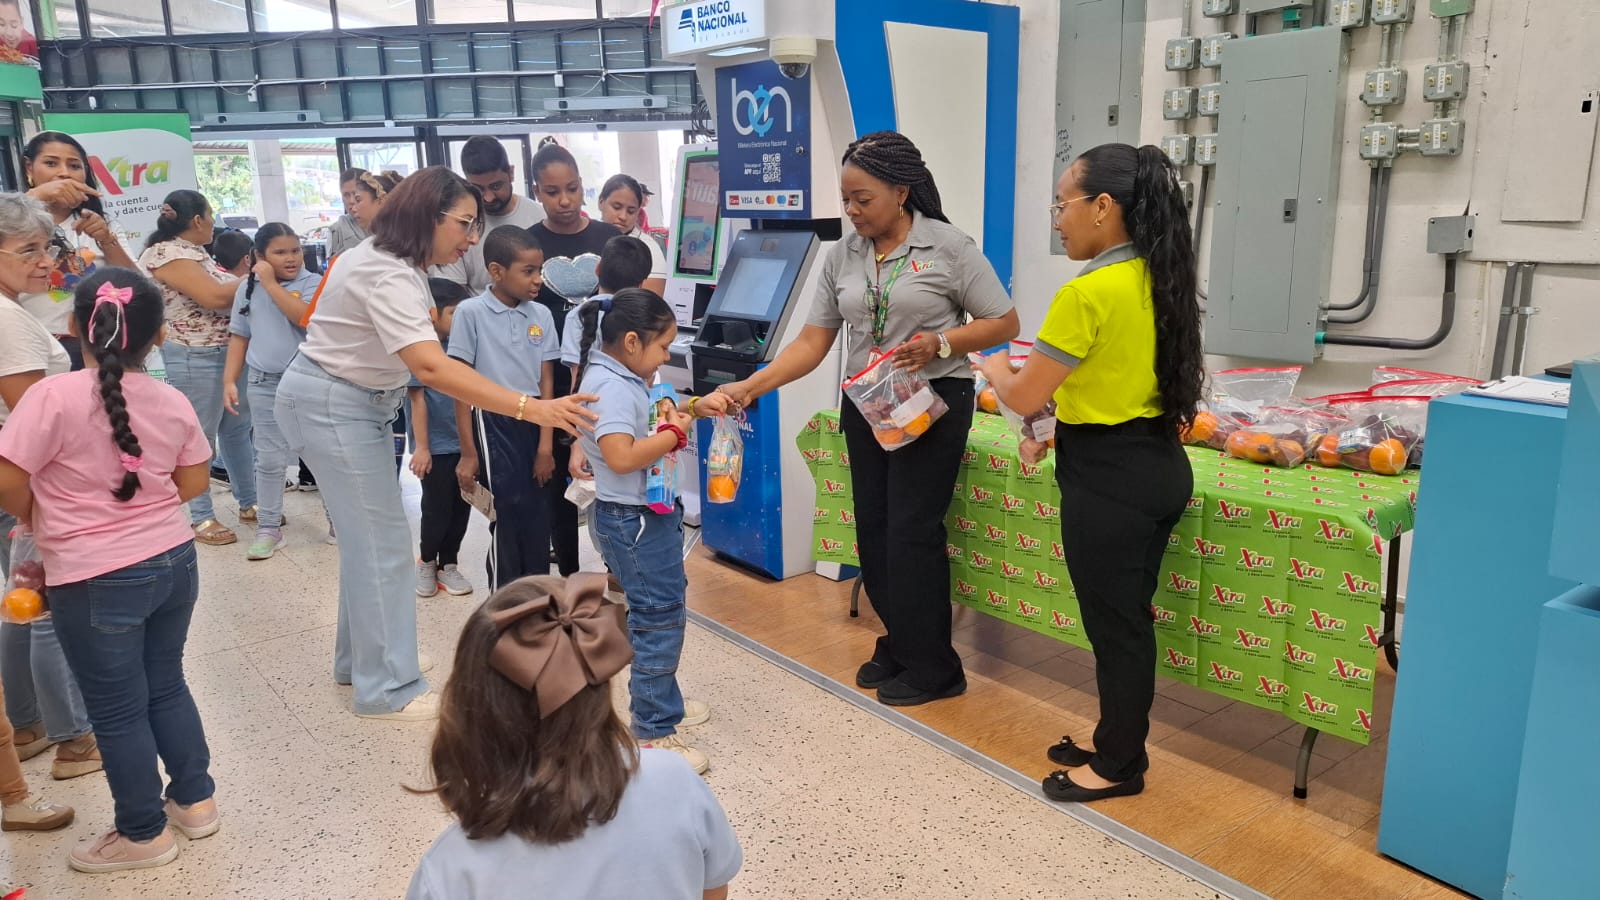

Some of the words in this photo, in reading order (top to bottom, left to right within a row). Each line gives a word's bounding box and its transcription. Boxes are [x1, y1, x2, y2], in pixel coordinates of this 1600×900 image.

[697, 1, 730, 18] BANCO
[698, 12, 747, 31] NACIONAL
[85, 155, 169, 195] Xtra
[105, 200, 114, 208] la
[116, 196, 149, 207] cuenta
[741, 196, 753, 204] VISA
[114, 210, 120, 218] y
[122, 206, 145, 216] date
[147, 204, 163, 212] cue
[908, 259, 934, 273] Xtra
[987, 454, 1010, 470] Xtra
[1018, 461, 1041, 477] Xtra
[821, 479, 845, 493] Xtra
[969, 486, 993, 501] Xtra
[1001, 493, 1025, 510] Xtra
[1034, 501, 1059, 517] Xtra
[1216, 500, 1251, 519] Xtra
[955, 516, 976, 531] Xtra
[1265, 509, 1302, 529] Xtra
[985, 524, 1007, 540] Xtra
[1315, 519, 1353, 539] Xtra
[818, 538, 842, 551] Xtra
[1016, 532, 1040, 548] Xtra
[1191, 537, 1225, 556] Xtra
[970, 551, 992, 567] Xtra
[1238, 548, 1274, 568] Xtra
[1001, 561, 1024, 577] Xtra
[1288, 558, 1325, 579] Xtra
[956, 579, 977, 594] Xtra
[1034, 570, 1059, 586] Xtra
[1167, 572, 1199, 591] Xtra
[1339, 571, 1378, 593] Xtra
[986, 589, 1008, 605] Xtra
[1210, 584, 1245, 604] Xtra
[1017, 599, 1040, 616] Xtra
[1259, 596, 1296, 616] Xtra
[1050, 610, 1076, 628] Xtra
[1187, 616, 1220, 635] Xtra
[1306, 609, 1346, 631] Xtra
[1234, 629, 1270, 648] Xtra
[1164, 648, 1197, 667] Xtra
[1283, 641, 1316, 664] Xtra
[1209, 662, 1243, 681] Xtra
[1329, 658, 1372, 681] Xtra
[1257, 676, 1290, 696] Xtra
[1299, 691, 1338, 715] Xtra
